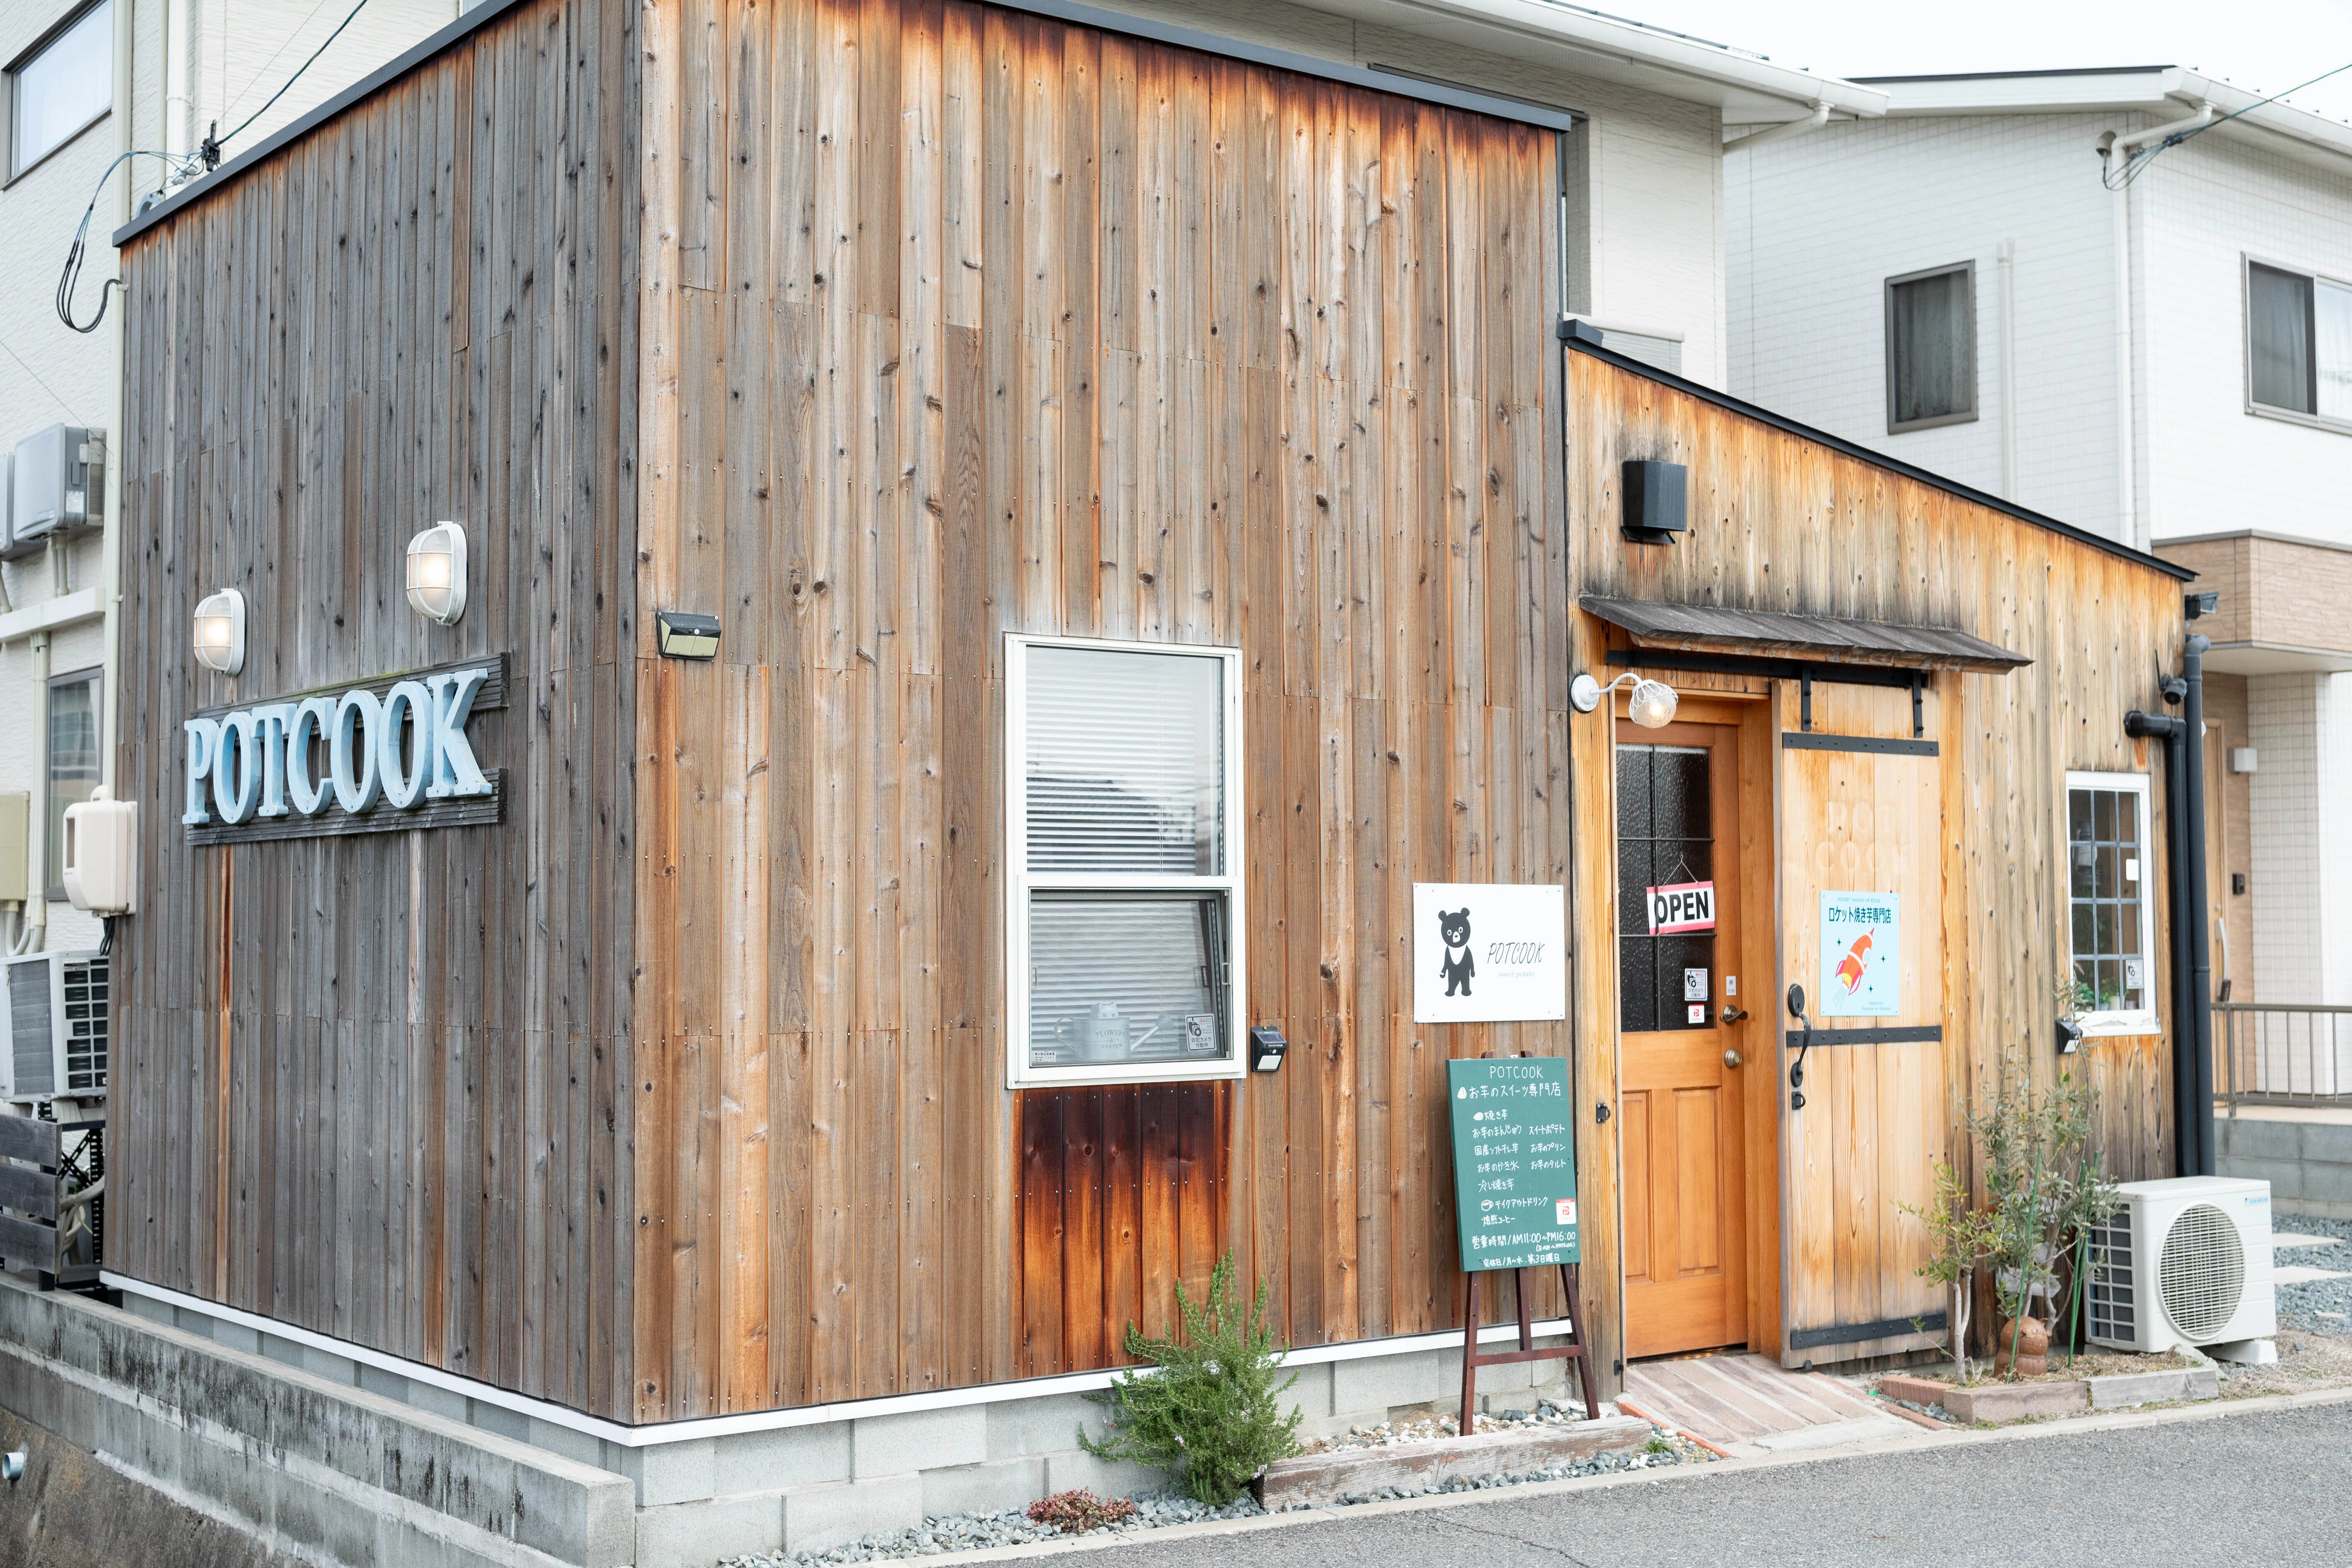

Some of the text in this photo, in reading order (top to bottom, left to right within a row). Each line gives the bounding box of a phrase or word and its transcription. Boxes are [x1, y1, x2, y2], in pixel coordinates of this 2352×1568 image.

[182, 668, 492, 825] POTCOOK
[1654, 891, 1708, 924] OPEN
[1829, 906, 1891, 924] ロケット焼き芋専門店
[1487, 942, 1545, 964] POTCOOK
[1096, 1029, 1125, 1038] FLOWERS
[1490, 1065, 1543, 1079] POTCOOK
[1469, 1081, 1561, 1099] お芋のスイーツ専門店
[1484, 1109, 1508, 1120] 焼き芋
[1472, 1123, 1566, 1139] お芋のまんじゅう スイートポテト
[1530, 1142, 1566, 1153] お芋のプリン
[1477, 1159, 1566, 1173] お芋のかき氷 お芋のタルト
[1495, 1197, 1548, 1210] テイクアウトドリンク
[1481, 1214, 1515, 1227] 焙煎コーヒー
